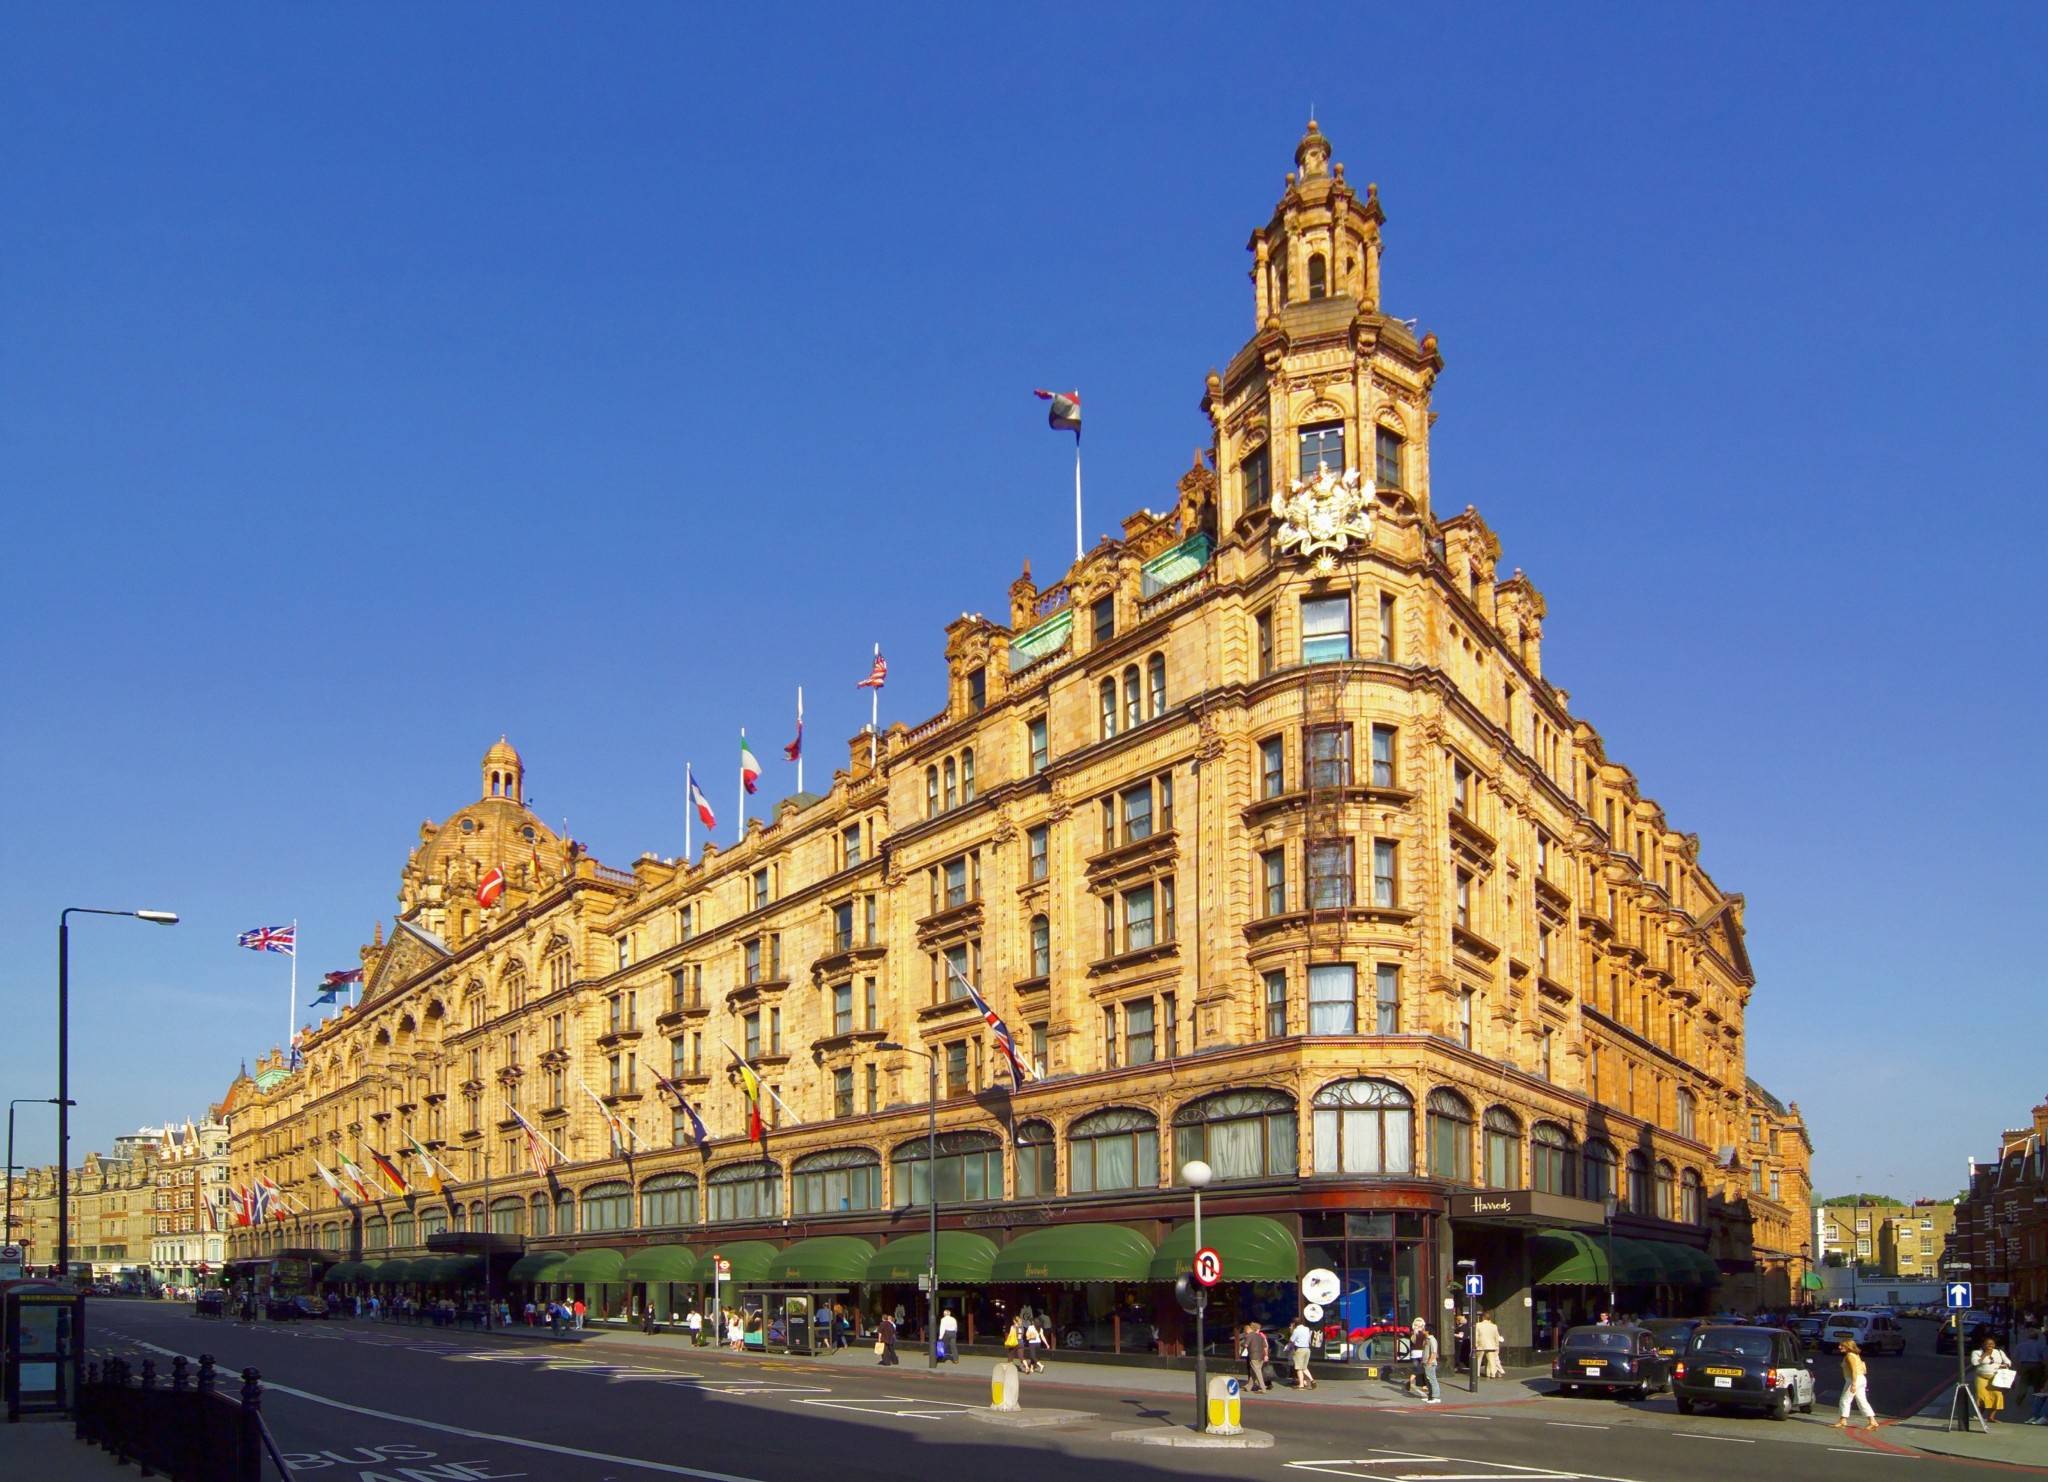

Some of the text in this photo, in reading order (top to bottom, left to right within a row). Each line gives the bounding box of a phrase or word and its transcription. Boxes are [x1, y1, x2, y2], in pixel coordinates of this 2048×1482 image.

[1470, 1196, 1511, 1213] Harrods
[1175, 1259, 1194, 1276] Harr
[268, 1444, 438, 1471] BUS
